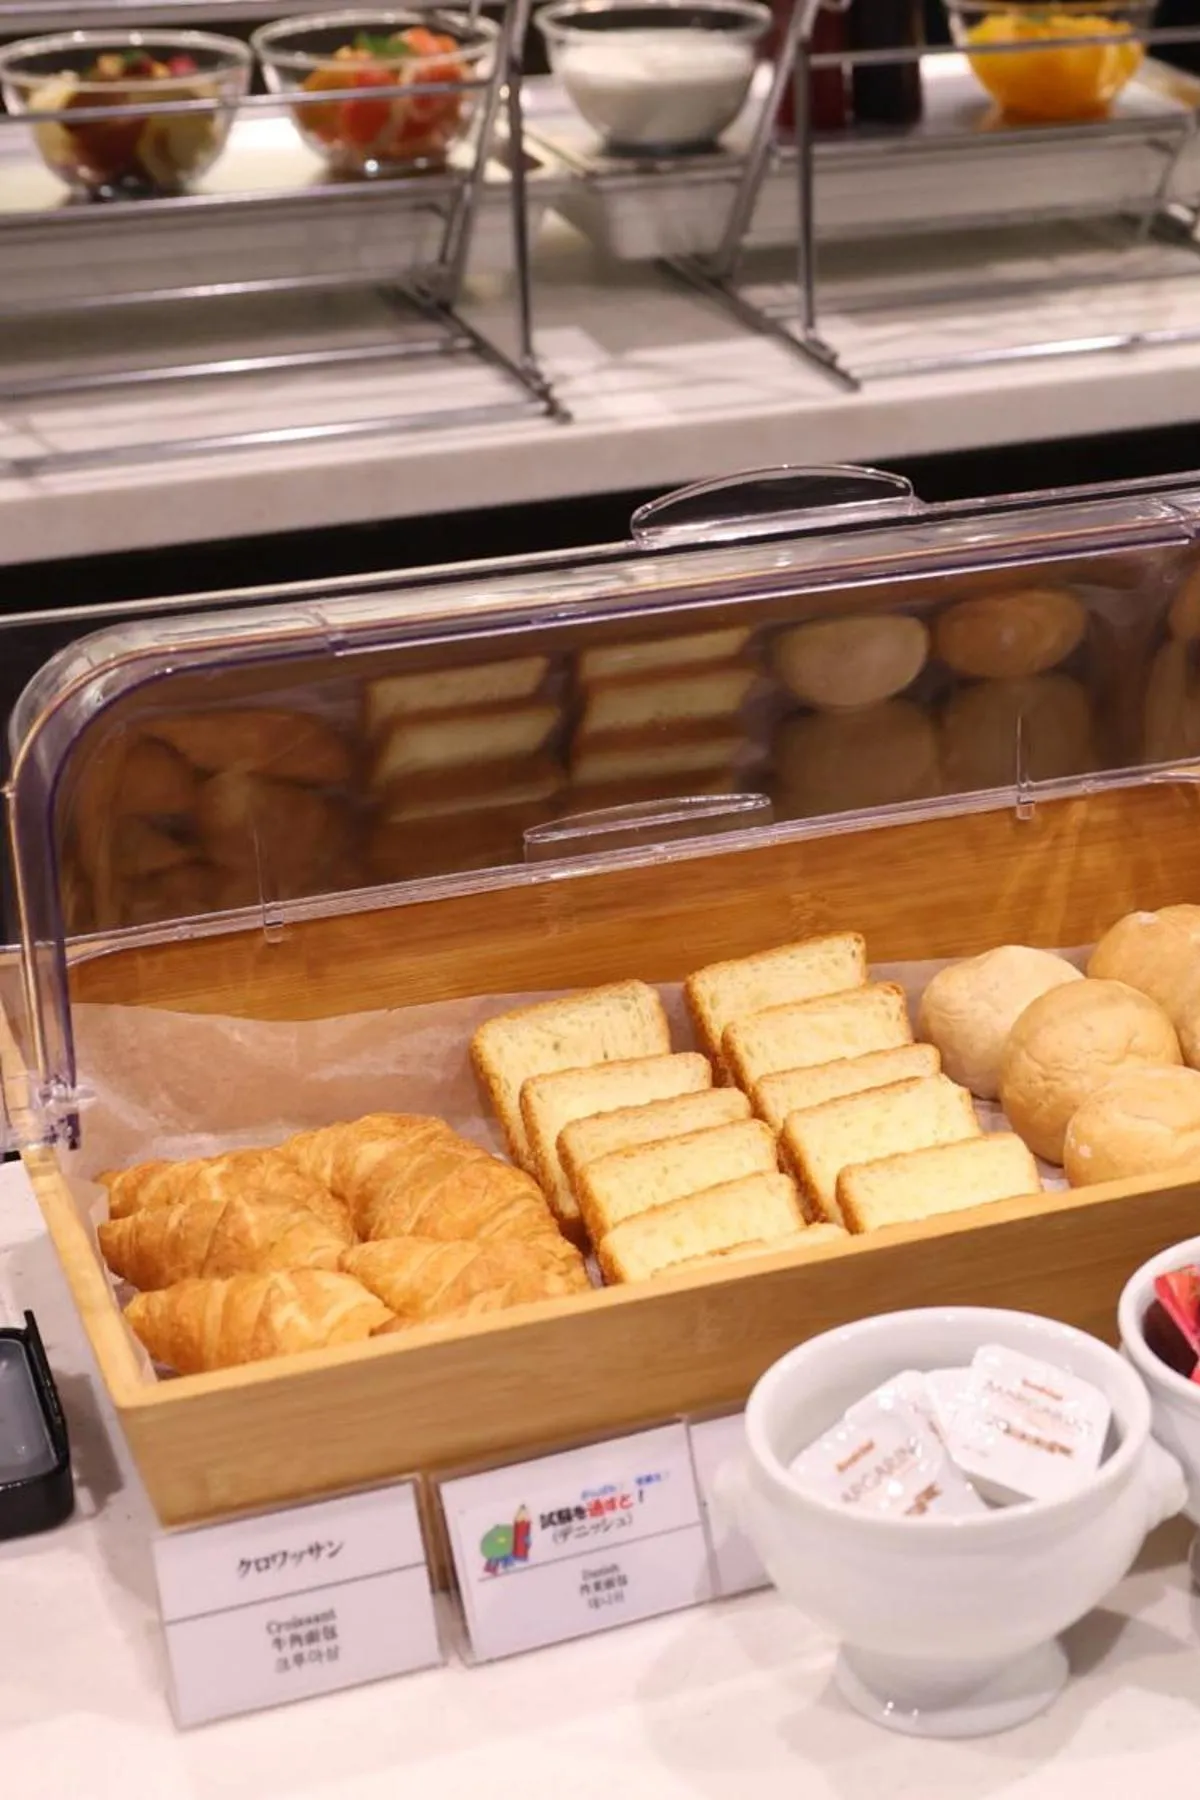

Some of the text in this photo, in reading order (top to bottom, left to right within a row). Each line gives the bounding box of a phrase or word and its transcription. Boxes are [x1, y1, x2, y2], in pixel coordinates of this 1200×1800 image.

[237, 1540, 345, 1579] クロワッサン
[265, 1607, 337, 1636] Croissant
